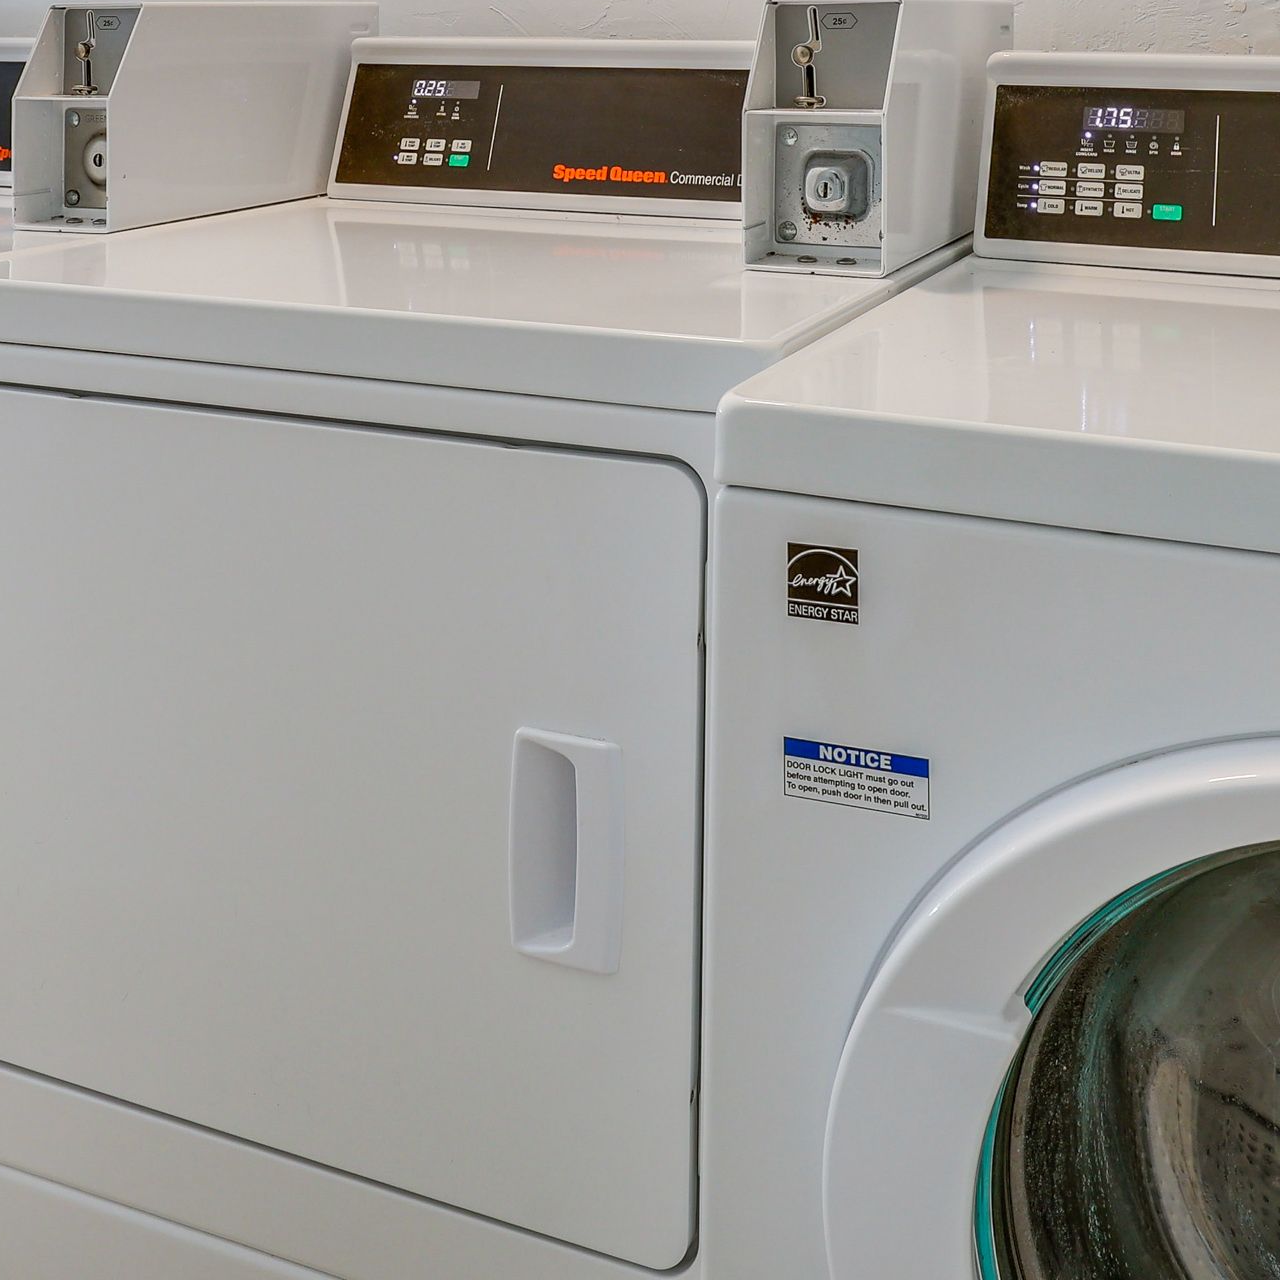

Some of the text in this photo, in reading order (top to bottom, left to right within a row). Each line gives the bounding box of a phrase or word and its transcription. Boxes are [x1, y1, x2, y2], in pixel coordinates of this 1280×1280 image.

[553, 164, 608, 182] Speed
[670, 171, 735, 187] Commercial
[792, 573, 834, 594] energy
[789, 603, 857, 622] ENERGY STAR
[819, 745, 892, 770] NOTICE
[786, 771, 911, 798] before attempting to open door.
[787, 760, 914, 788] DOOR LOCK LIGHT must go out
[786, 780, 927, 812] To open, push door in then pull out.
